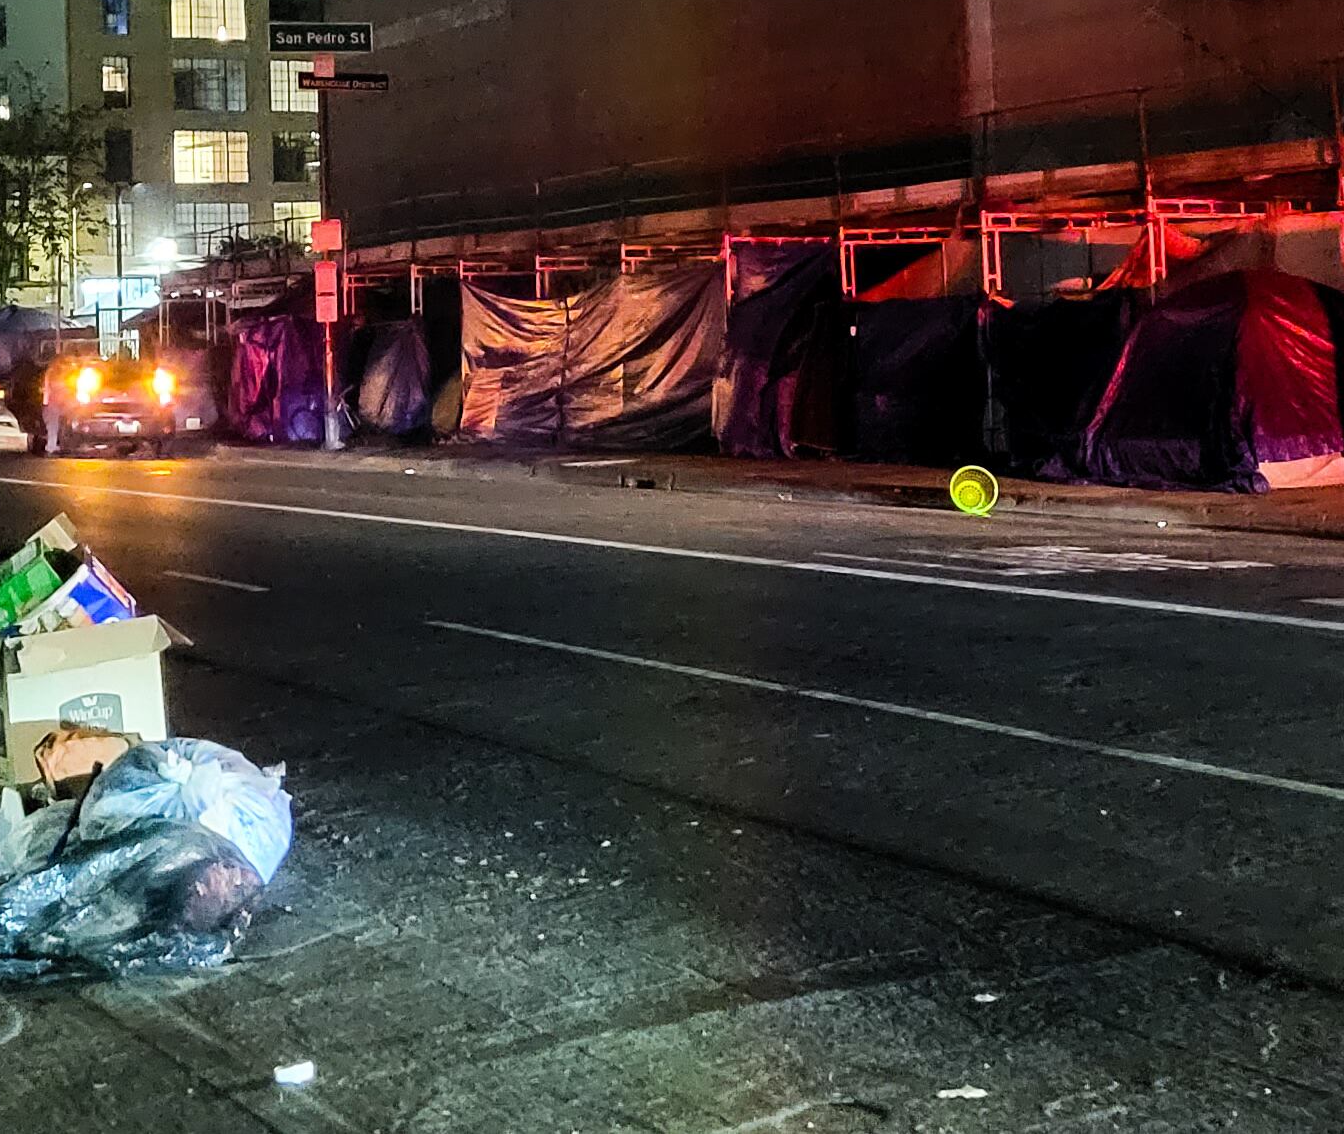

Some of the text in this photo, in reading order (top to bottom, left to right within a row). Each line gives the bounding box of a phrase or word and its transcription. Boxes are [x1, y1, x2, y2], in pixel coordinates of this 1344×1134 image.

[275, 32, 366, 45] San Pedro St
[68, 706, 114, 723] WinCup
